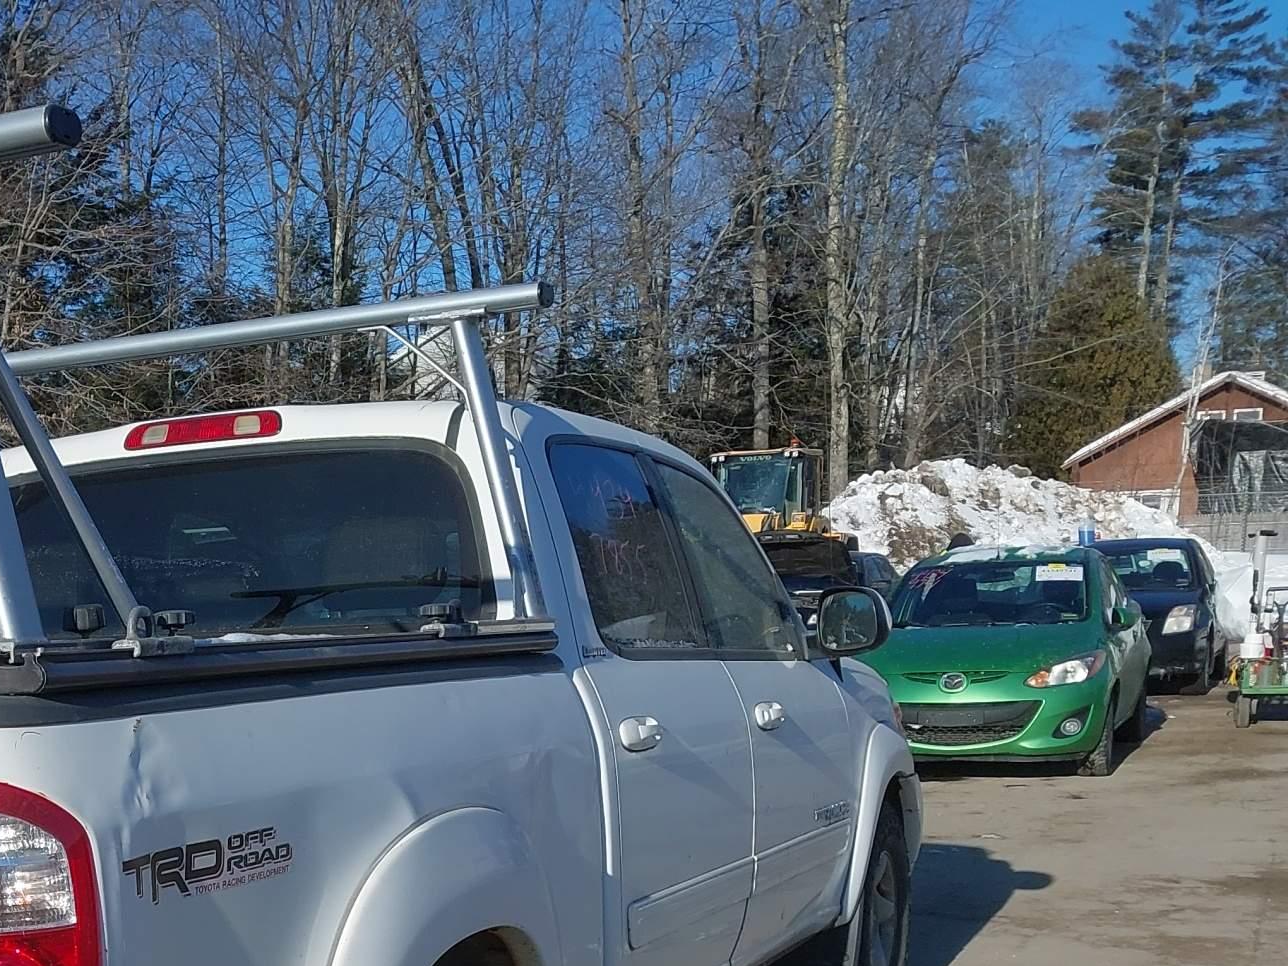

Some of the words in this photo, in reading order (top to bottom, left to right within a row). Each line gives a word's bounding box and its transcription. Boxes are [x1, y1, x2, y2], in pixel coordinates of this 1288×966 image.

[227, 826, 276, 853] OFF
[122, 839, 224, 905] TRD
[226, 843, 293, 875] ROAD
[195, 883, 220, 896] TOYOTA
[222, 875, 246, 891] RACING
[247, 865, 290, 884] DEVELOPMENT
